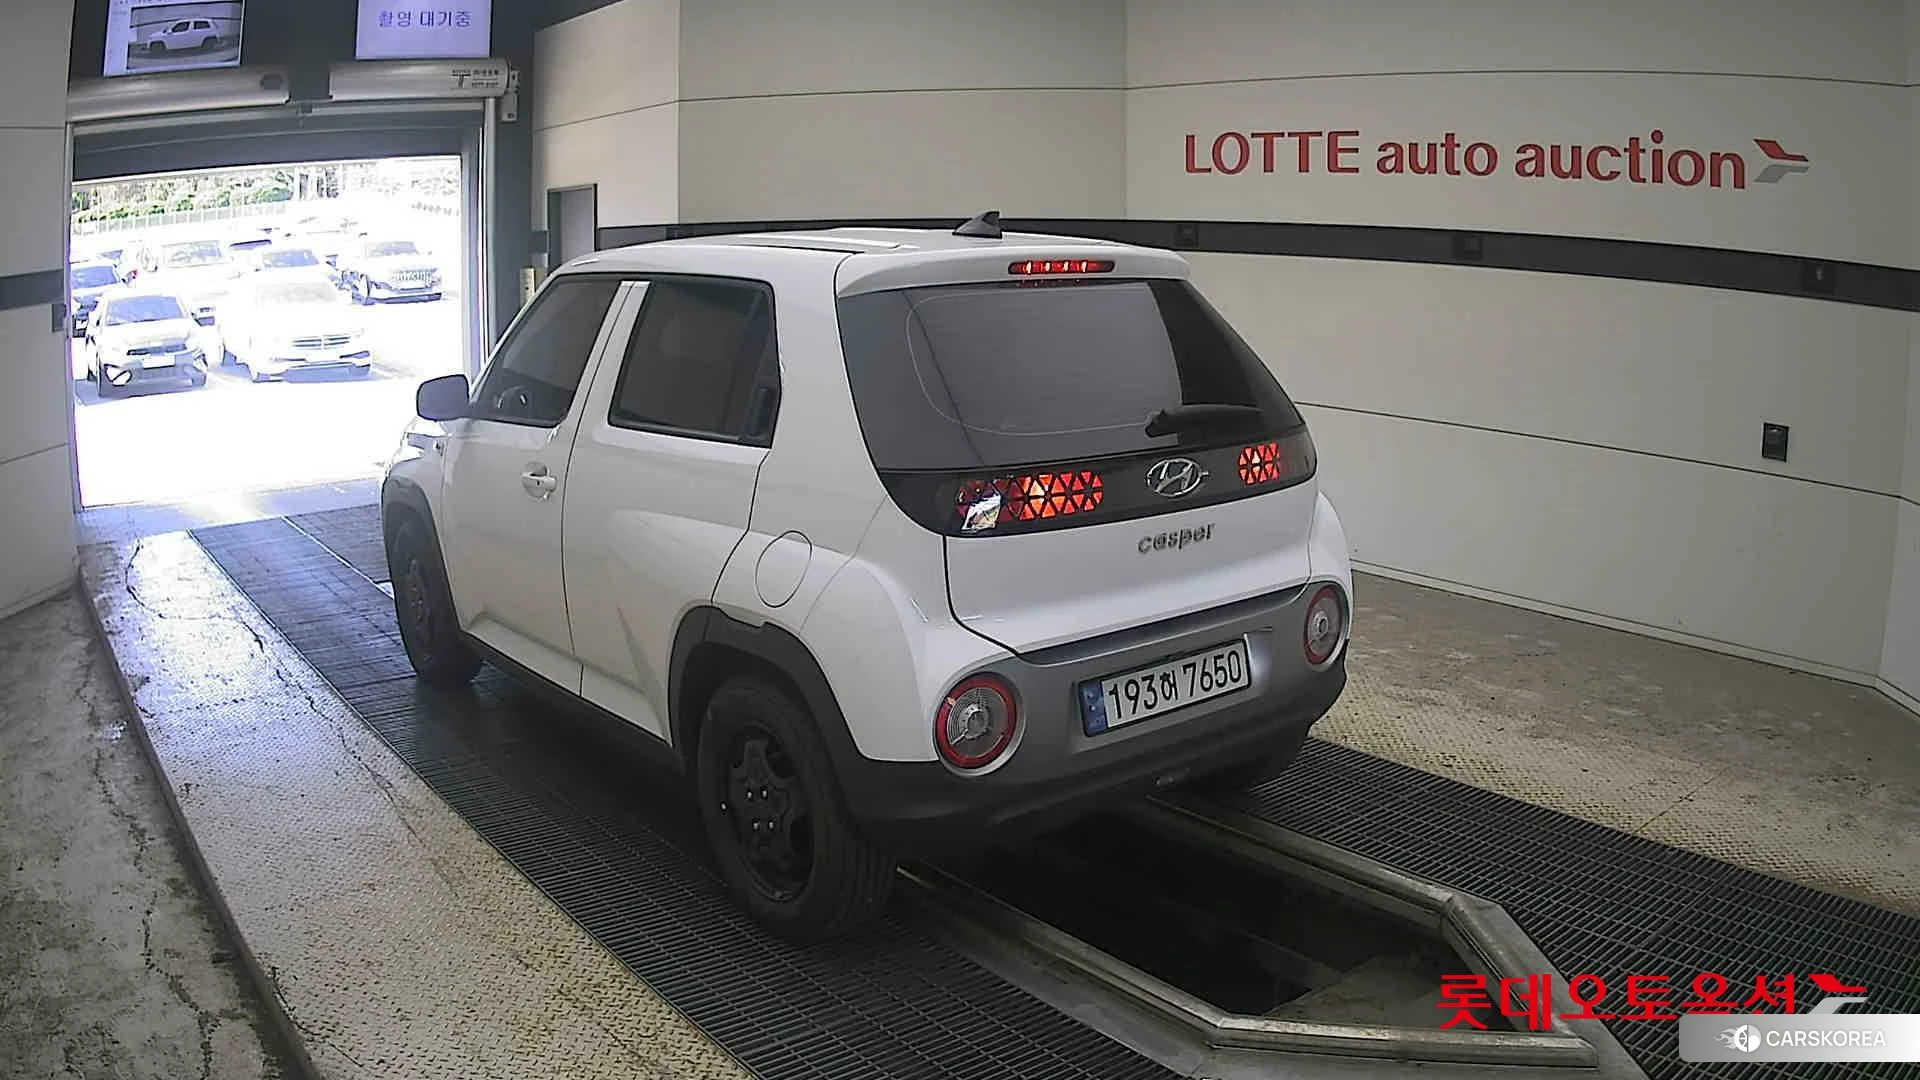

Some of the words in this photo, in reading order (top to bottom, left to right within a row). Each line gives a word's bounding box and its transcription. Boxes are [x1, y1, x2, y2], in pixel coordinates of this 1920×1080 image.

[420, 10, 472, 28] 대기중
[1185, 130, 1360, 174] LOTTE
[1376, 132, 1498, 176] auto
[1515, 130, 1746, 190] auction
[1137, 523, 1216, 553] casper
[1108, 670, 1179, 719] 193허
[1182, 650, 1242, 697] 7650
